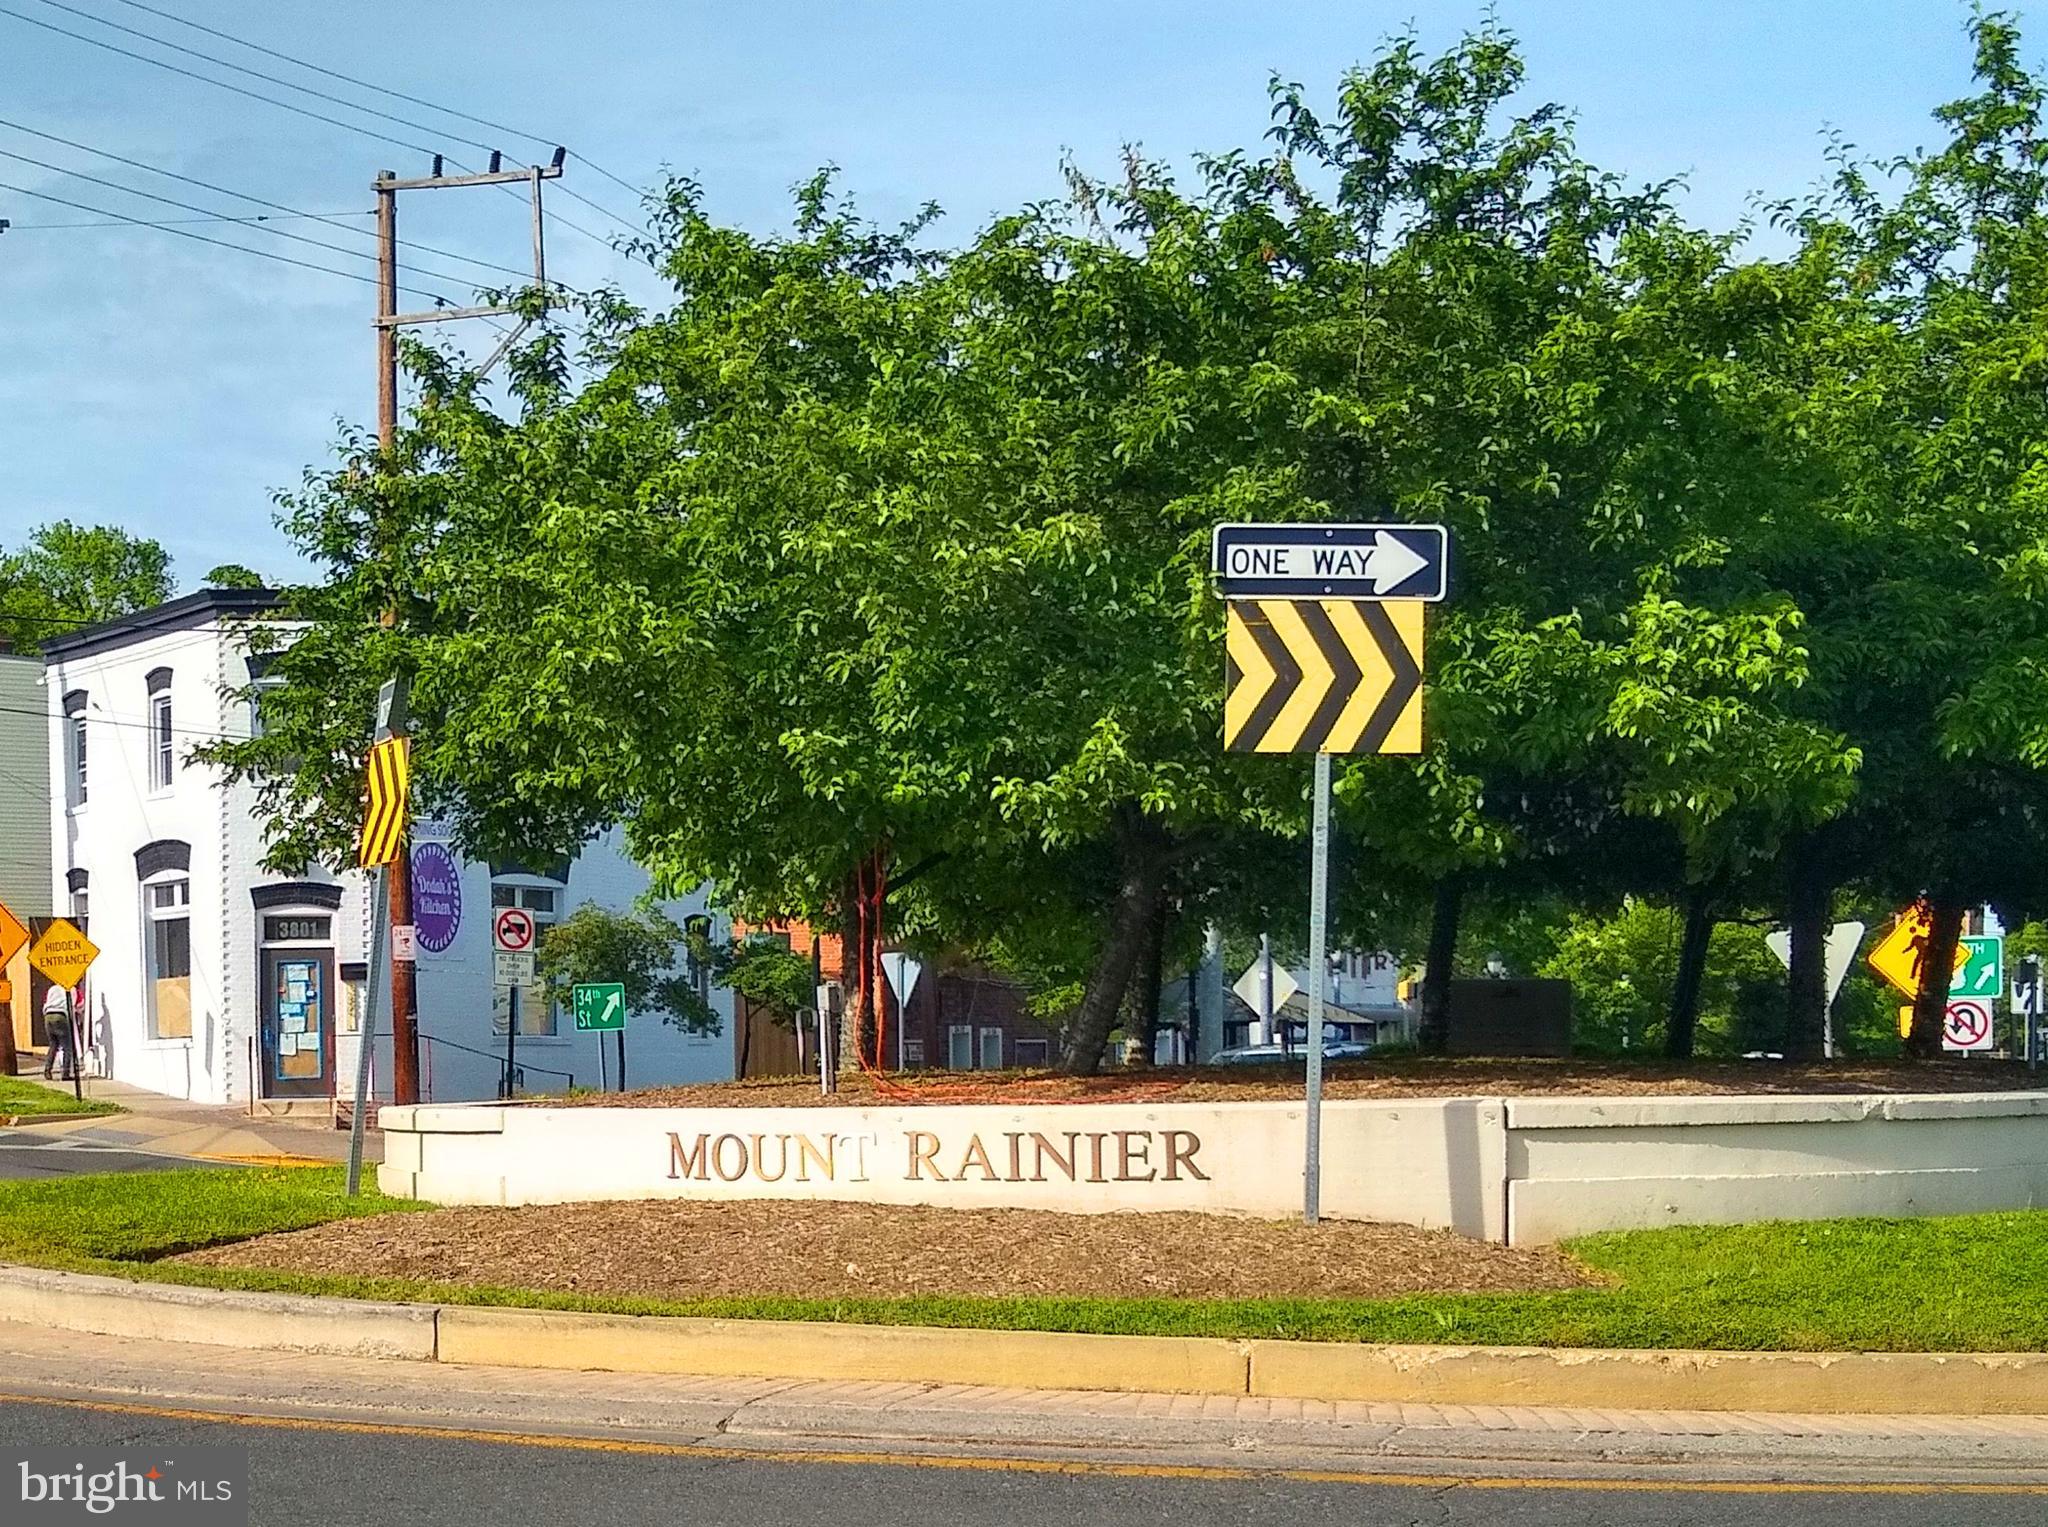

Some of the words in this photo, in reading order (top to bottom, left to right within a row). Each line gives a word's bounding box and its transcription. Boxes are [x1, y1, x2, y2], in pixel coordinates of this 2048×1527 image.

[1232, 548, 1290, 575] ONE
[1312, 549, 1375, 576] WAY
[419, 896, 452, 916] Kitchen
[279, 921, 319, 938] 3801
[45, 940, 81, 952] HIDDEN
[40, 953, 89, 968] ENTRANCE
[577, 988, 601, 1006] 34th
[578, 1009, 592, 1027] St
[666, 1130, 877, 1182] MOUNT
[903, 1129, 1212, 1183] RAINIER
